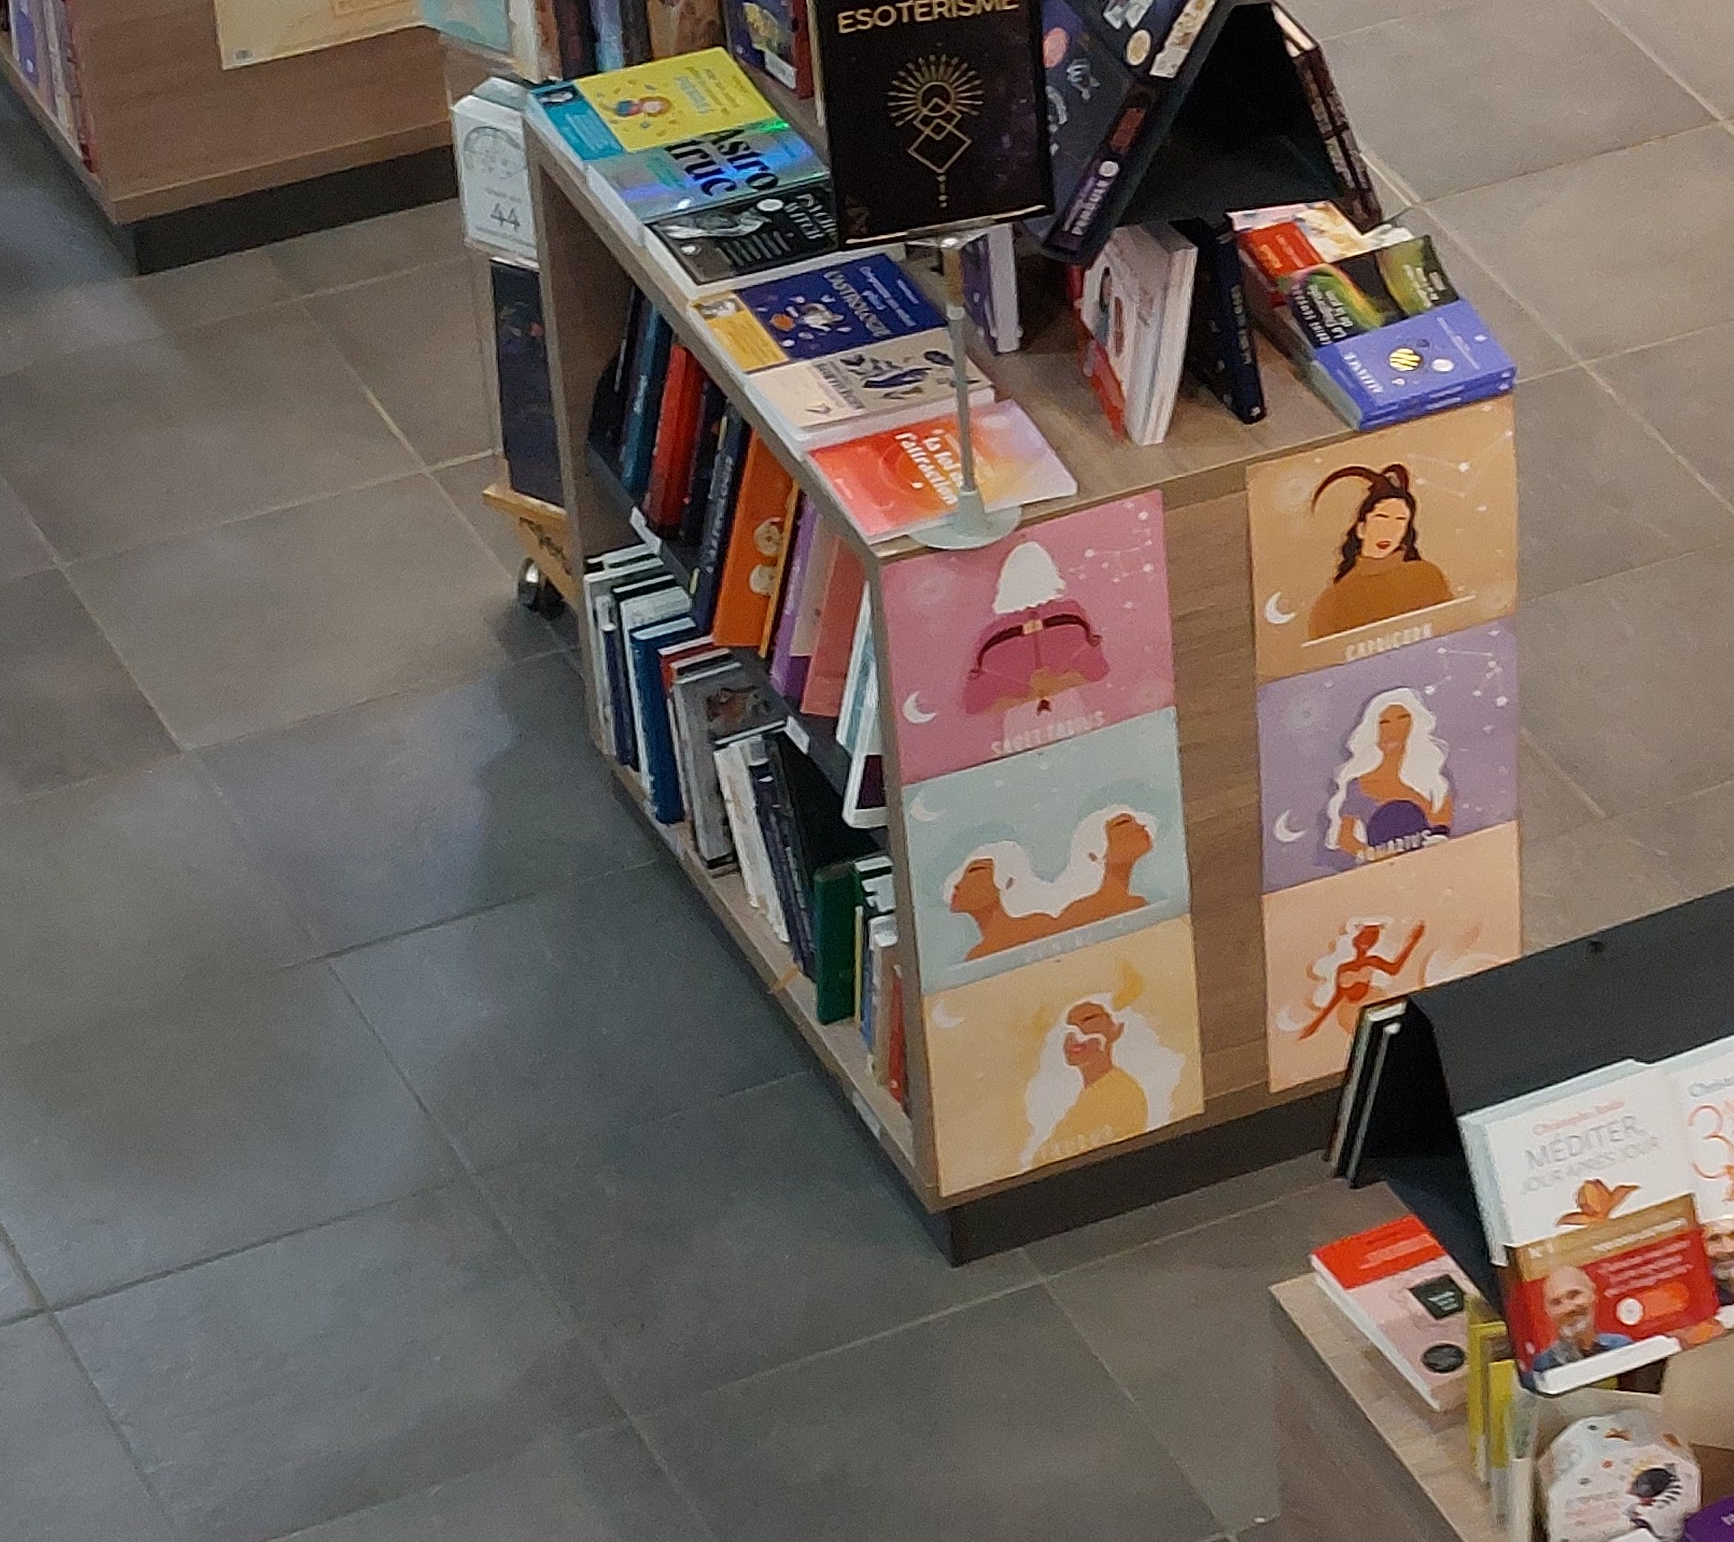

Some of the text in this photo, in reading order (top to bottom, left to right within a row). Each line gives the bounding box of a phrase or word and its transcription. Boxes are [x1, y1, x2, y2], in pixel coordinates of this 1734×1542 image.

[664, 137, 739, 200] truc
[705, 126, 781, 196] Astro
[894, 430, 962, 507] l'attraction
